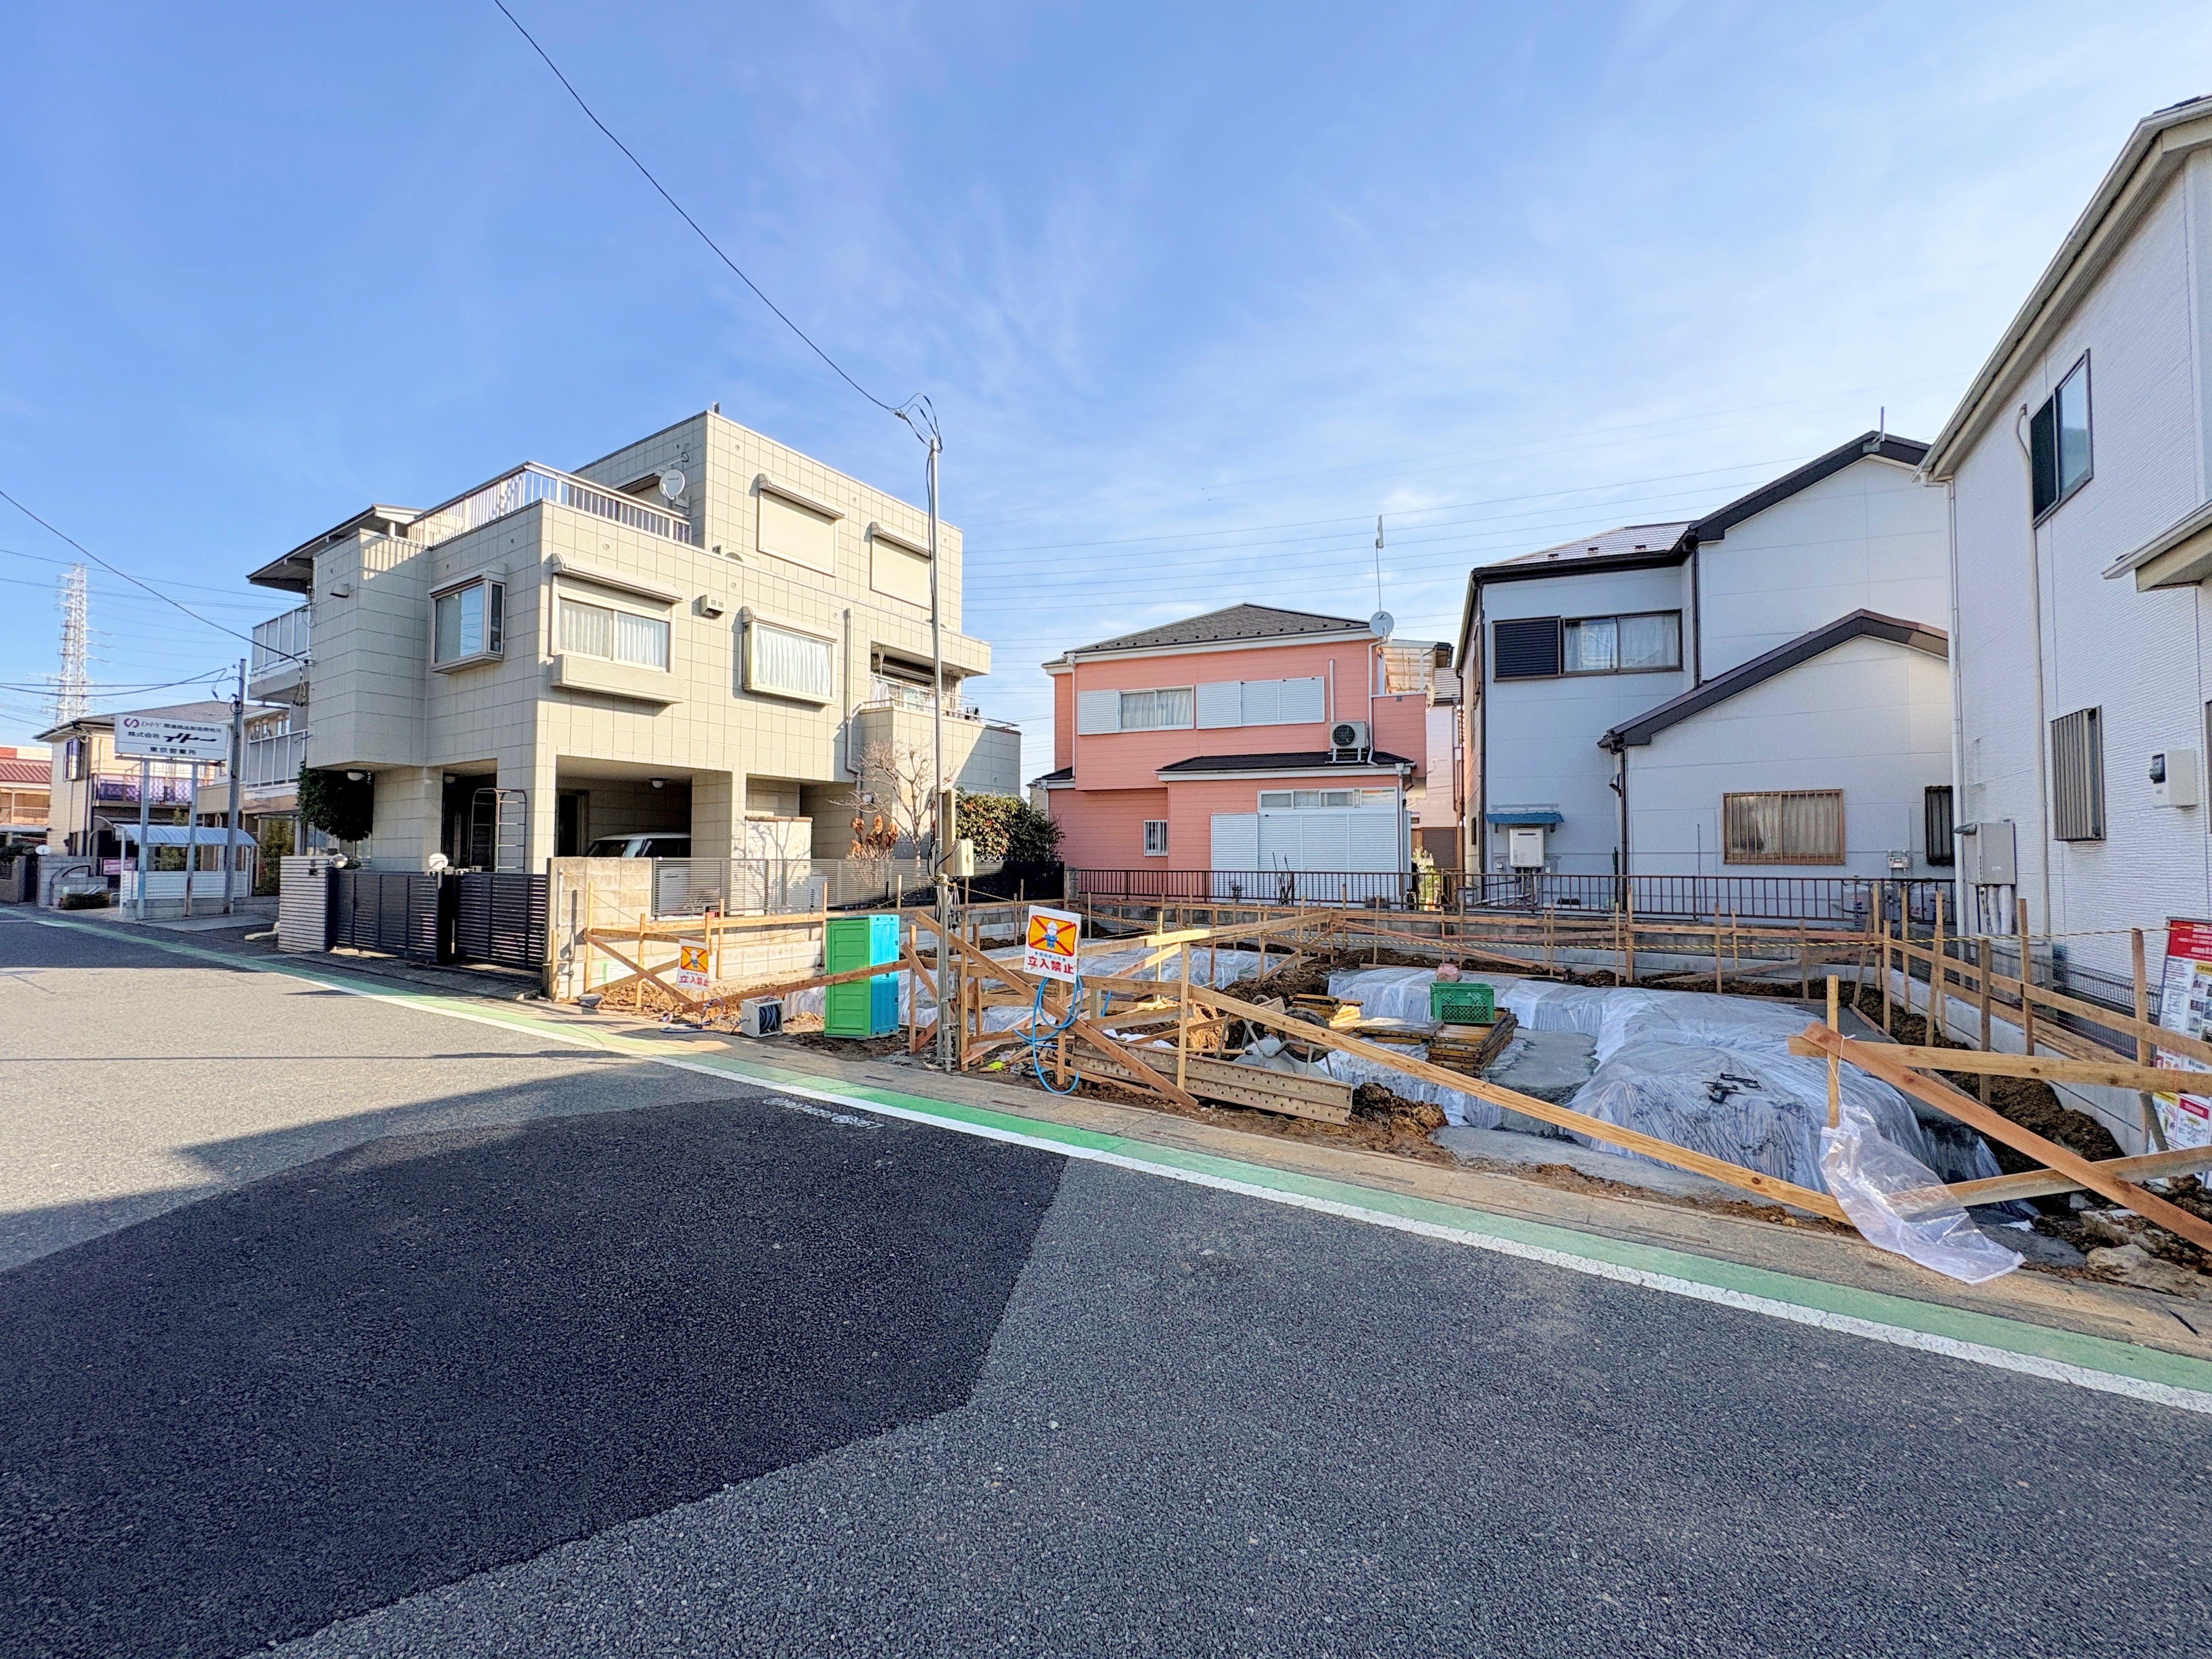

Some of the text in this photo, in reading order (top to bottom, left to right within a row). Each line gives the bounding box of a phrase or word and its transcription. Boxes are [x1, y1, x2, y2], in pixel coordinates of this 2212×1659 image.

[127, 731, 217, 743] 株式会社 イトー
[149, 746, 196, 756] 東京営業所
[1028, 956, 1074, 974] 立入禁止
[679, 975, 709, 986] 立入禁止
